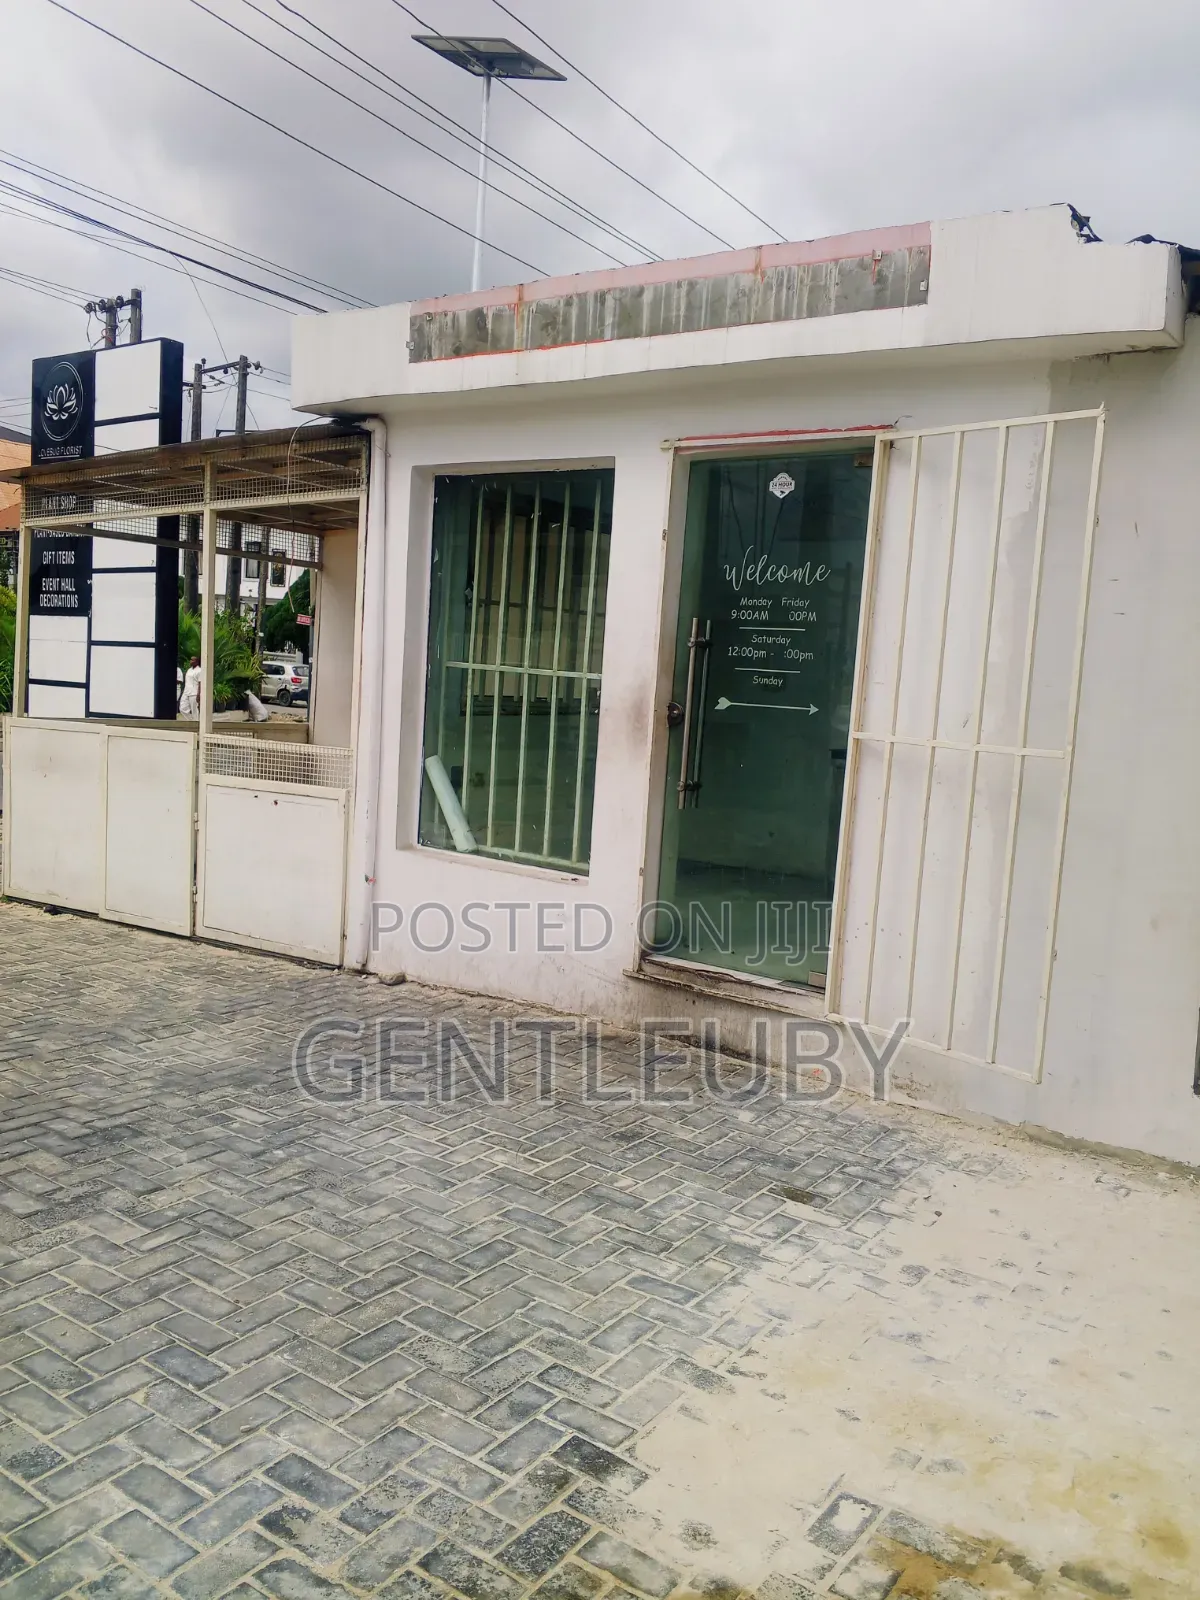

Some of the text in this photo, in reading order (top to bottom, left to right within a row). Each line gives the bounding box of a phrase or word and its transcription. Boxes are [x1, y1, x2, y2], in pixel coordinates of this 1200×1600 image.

[60, 445, 82, 455] FLORIST
[60, 495, 77, 510] SHOP
[42, 551, 75, 564] GIFT ITEMS
[723, 545, 831, 591] Welcome
[42, 578, 76, 591] EVENT HALL
[39, 594, 79, 608] DECORATIONS
[740, 597, 810, 608] Monday Friday
[731, 609, 769, 620] 9:00AM
[751, 635, 791, 646] Saturday
[728, 646, 767, 660] 12:00pm
[752, 676, 784, 687] Sunday
